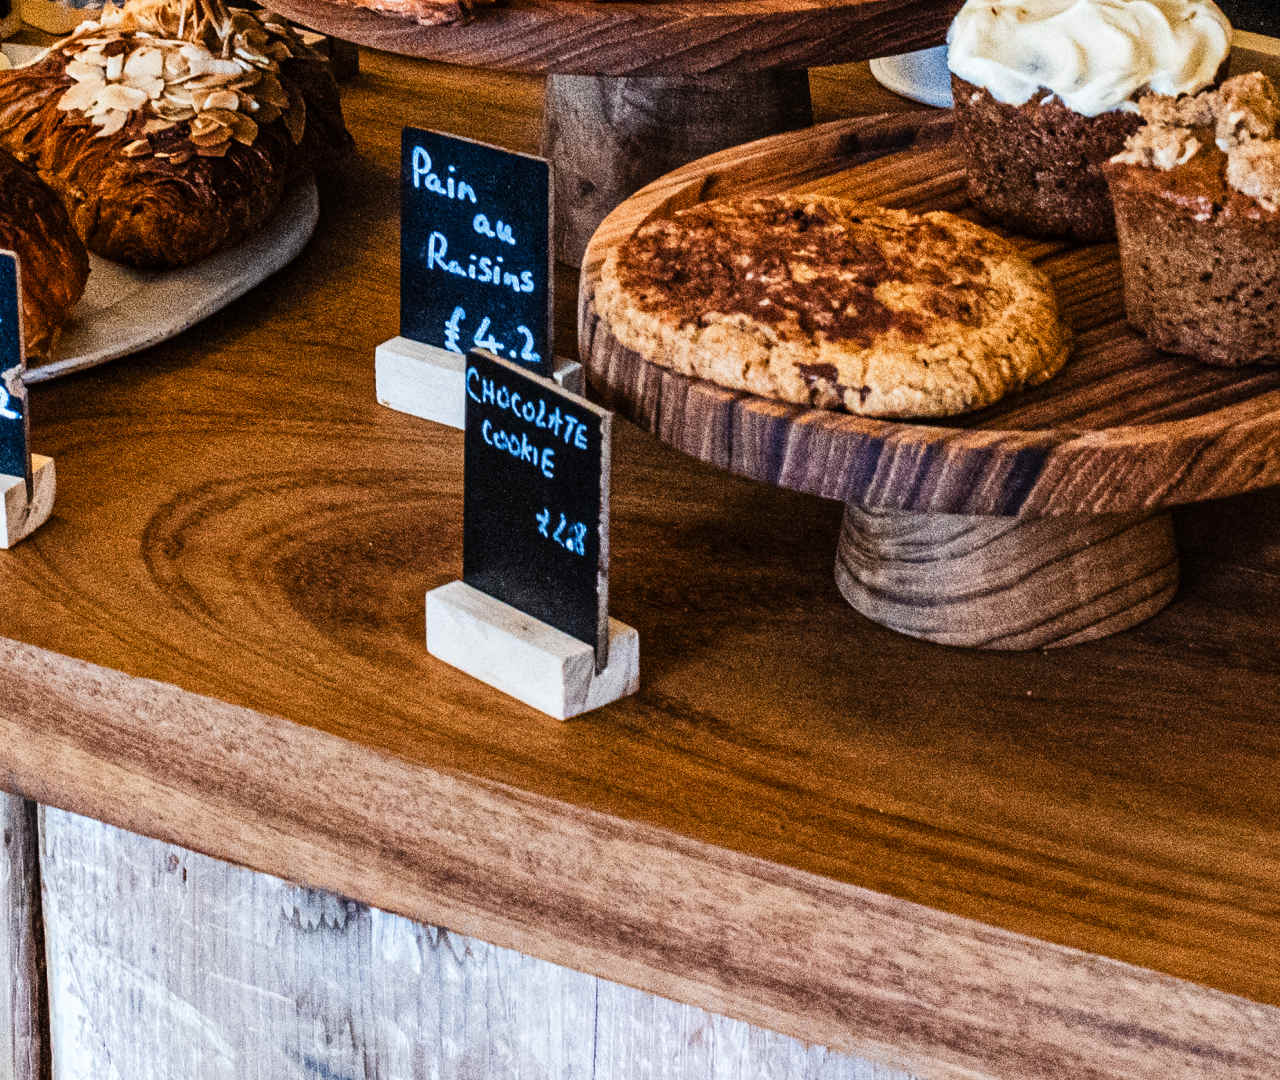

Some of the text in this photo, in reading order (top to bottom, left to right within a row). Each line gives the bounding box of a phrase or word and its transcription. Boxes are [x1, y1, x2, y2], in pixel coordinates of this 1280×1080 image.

[411, 144, 477, 204] Pain
[472, 212, 517, 246] au
[427, 230, 535, 293] Raisins
[465, 366, 589, 451] CHOCOLATE
[481, 418, 555, 480] COOKIE
